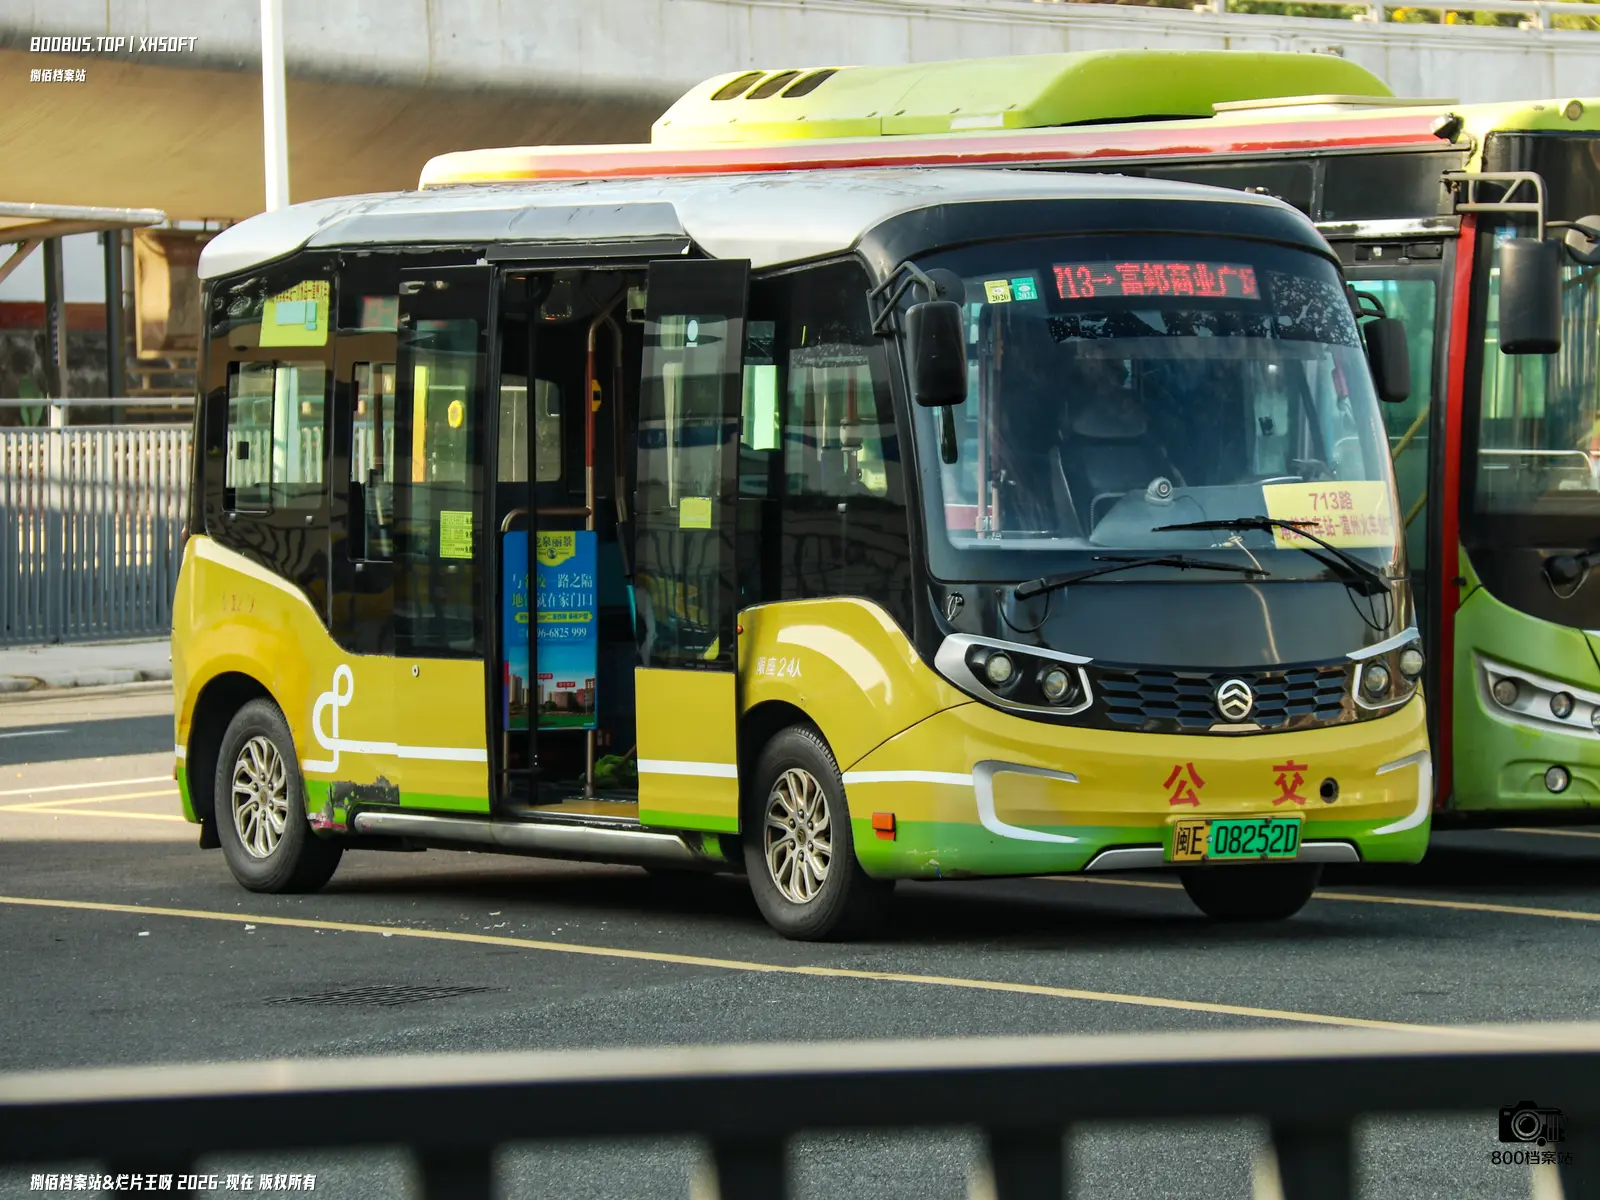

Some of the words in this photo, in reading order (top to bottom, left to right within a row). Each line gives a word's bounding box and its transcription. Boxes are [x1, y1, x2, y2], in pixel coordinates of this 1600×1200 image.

[991, 294, 1009, 302] 2020
[1018, 291, 1035, 299] 2021
[1308, 491, 1353, 512] 713路
[571, 627, 587, 638] 999
[1175, 826, 1204, 856] 闽E
[1214, 824, 1299, 855] 08252D
